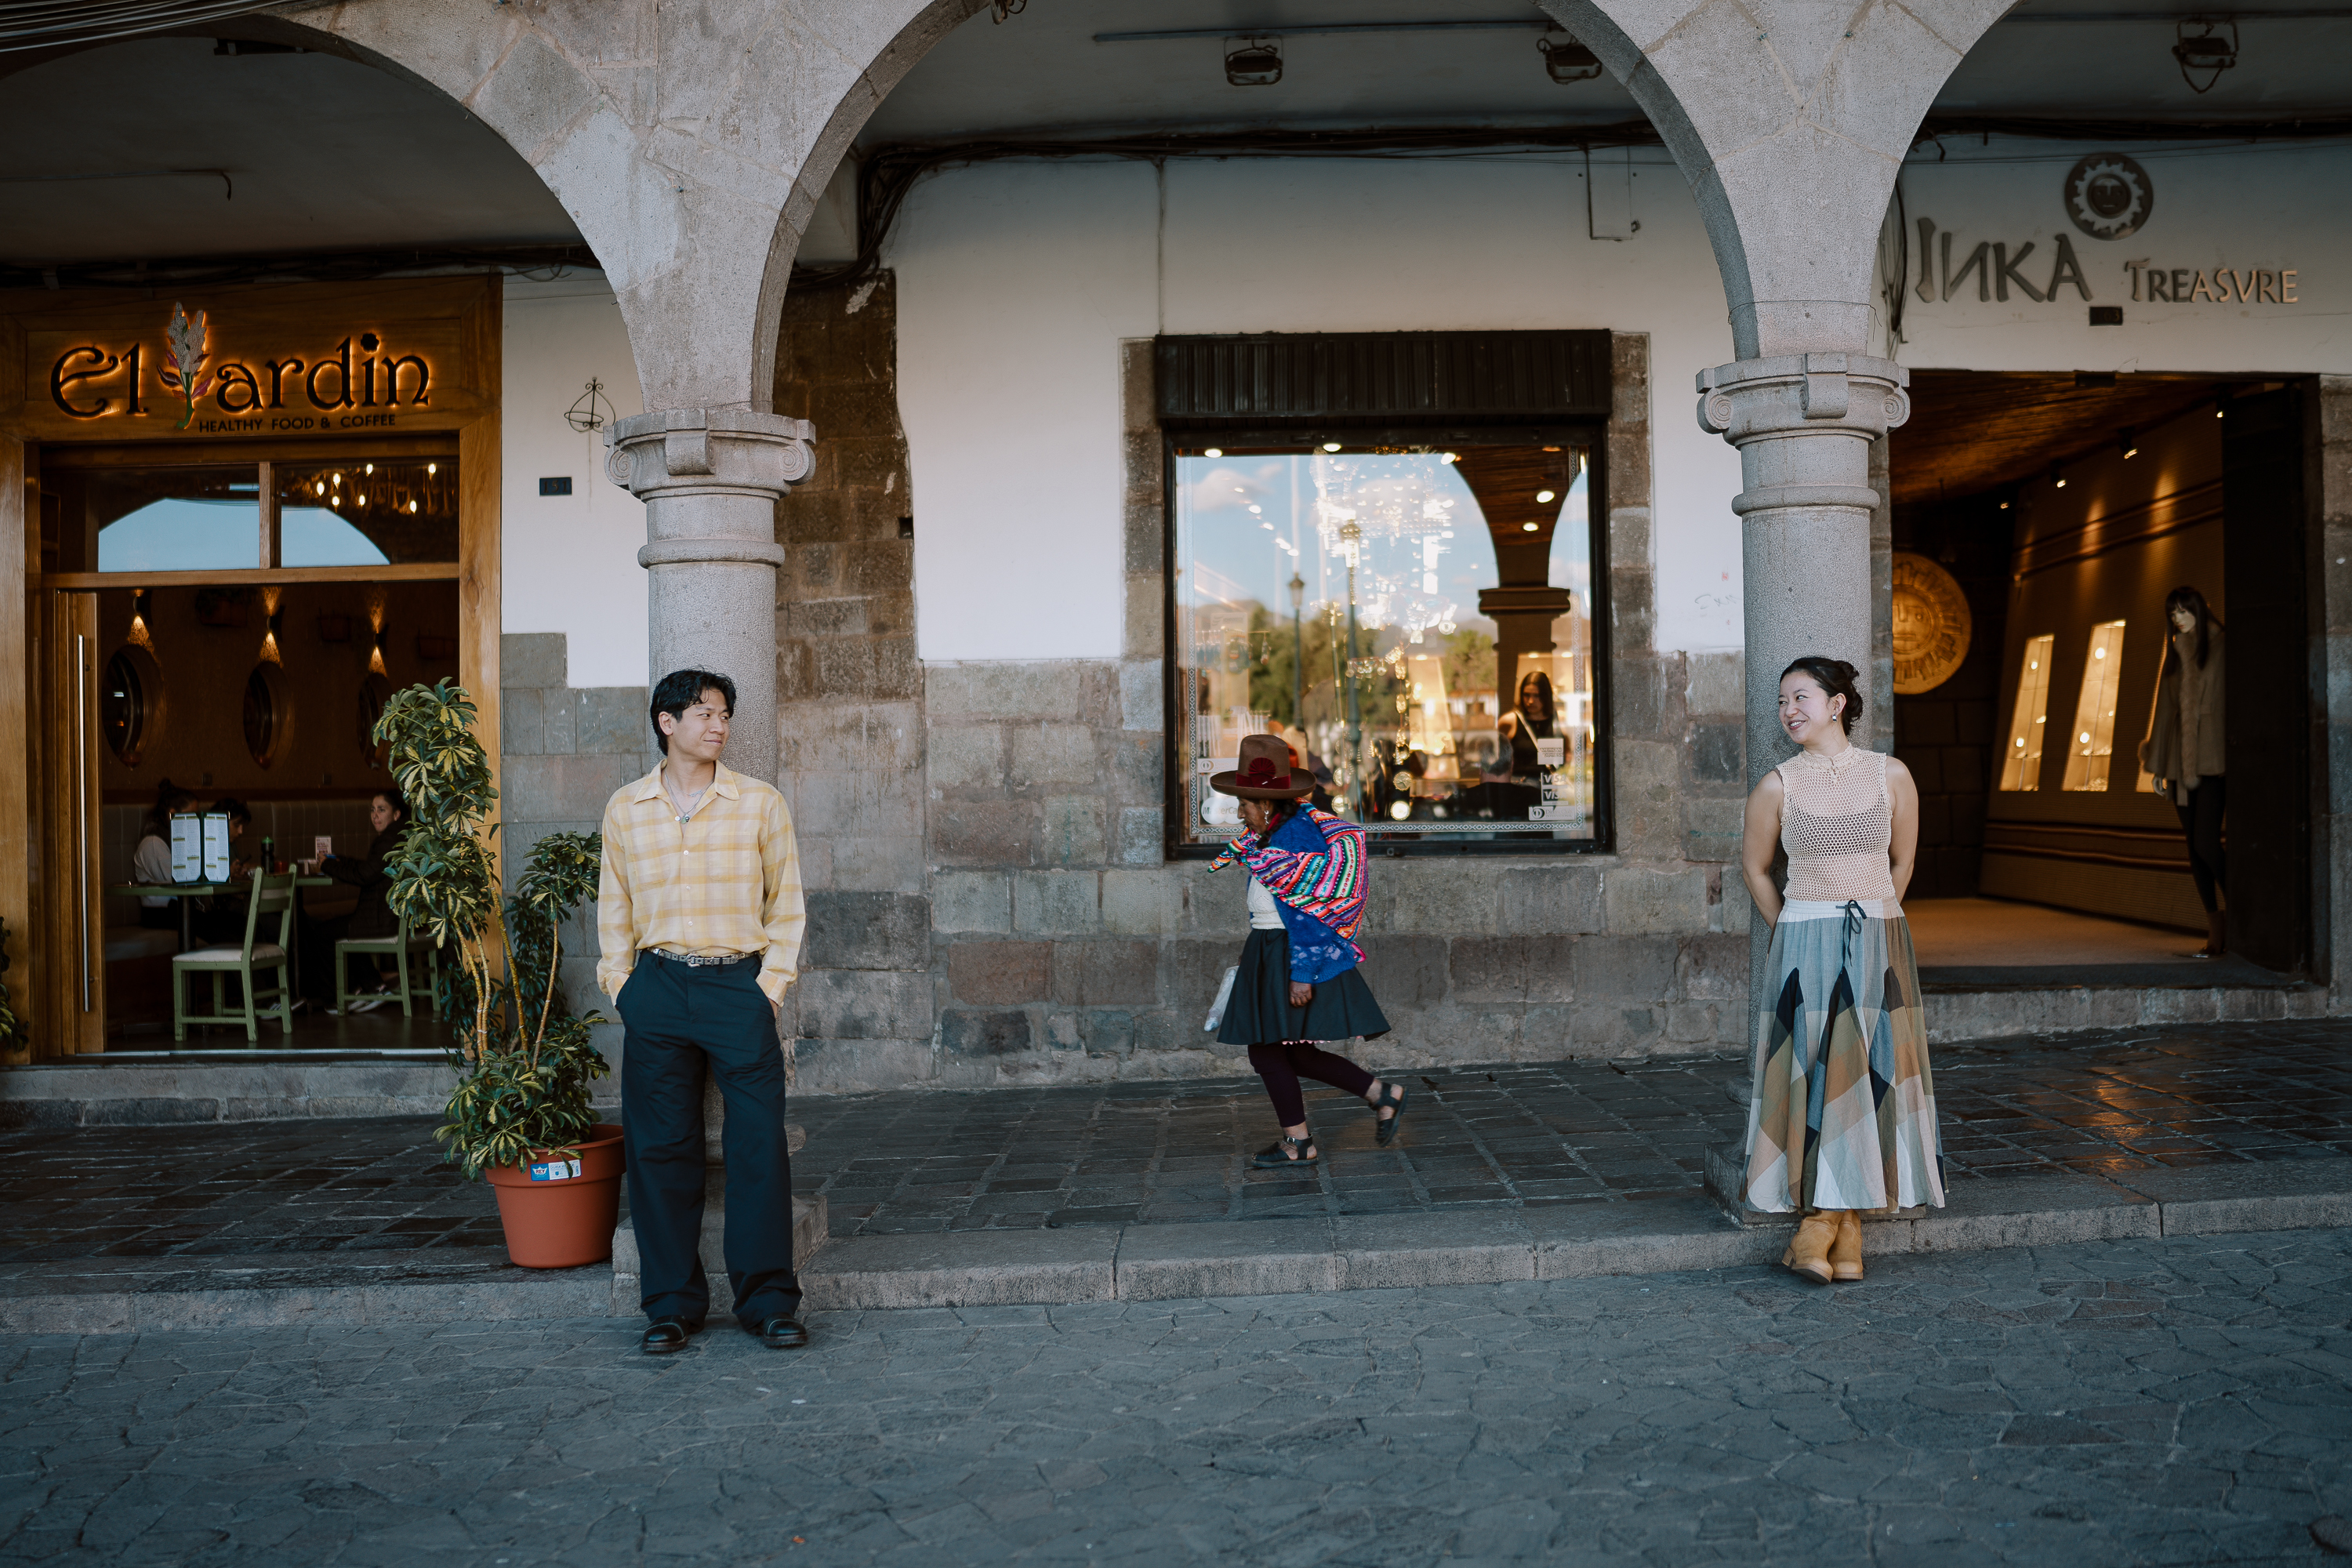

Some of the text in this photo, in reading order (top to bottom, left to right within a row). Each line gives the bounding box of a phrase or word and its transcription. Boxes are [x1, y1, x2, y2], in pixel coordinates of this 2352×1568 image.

[1916, 216, 2093, 303] INKA
[199, 414, 396, 433] HEALTHY FOOD & COFFEE
[543, 479, 568, 494] 151
[1543, 775, 1567, 783] VISA
